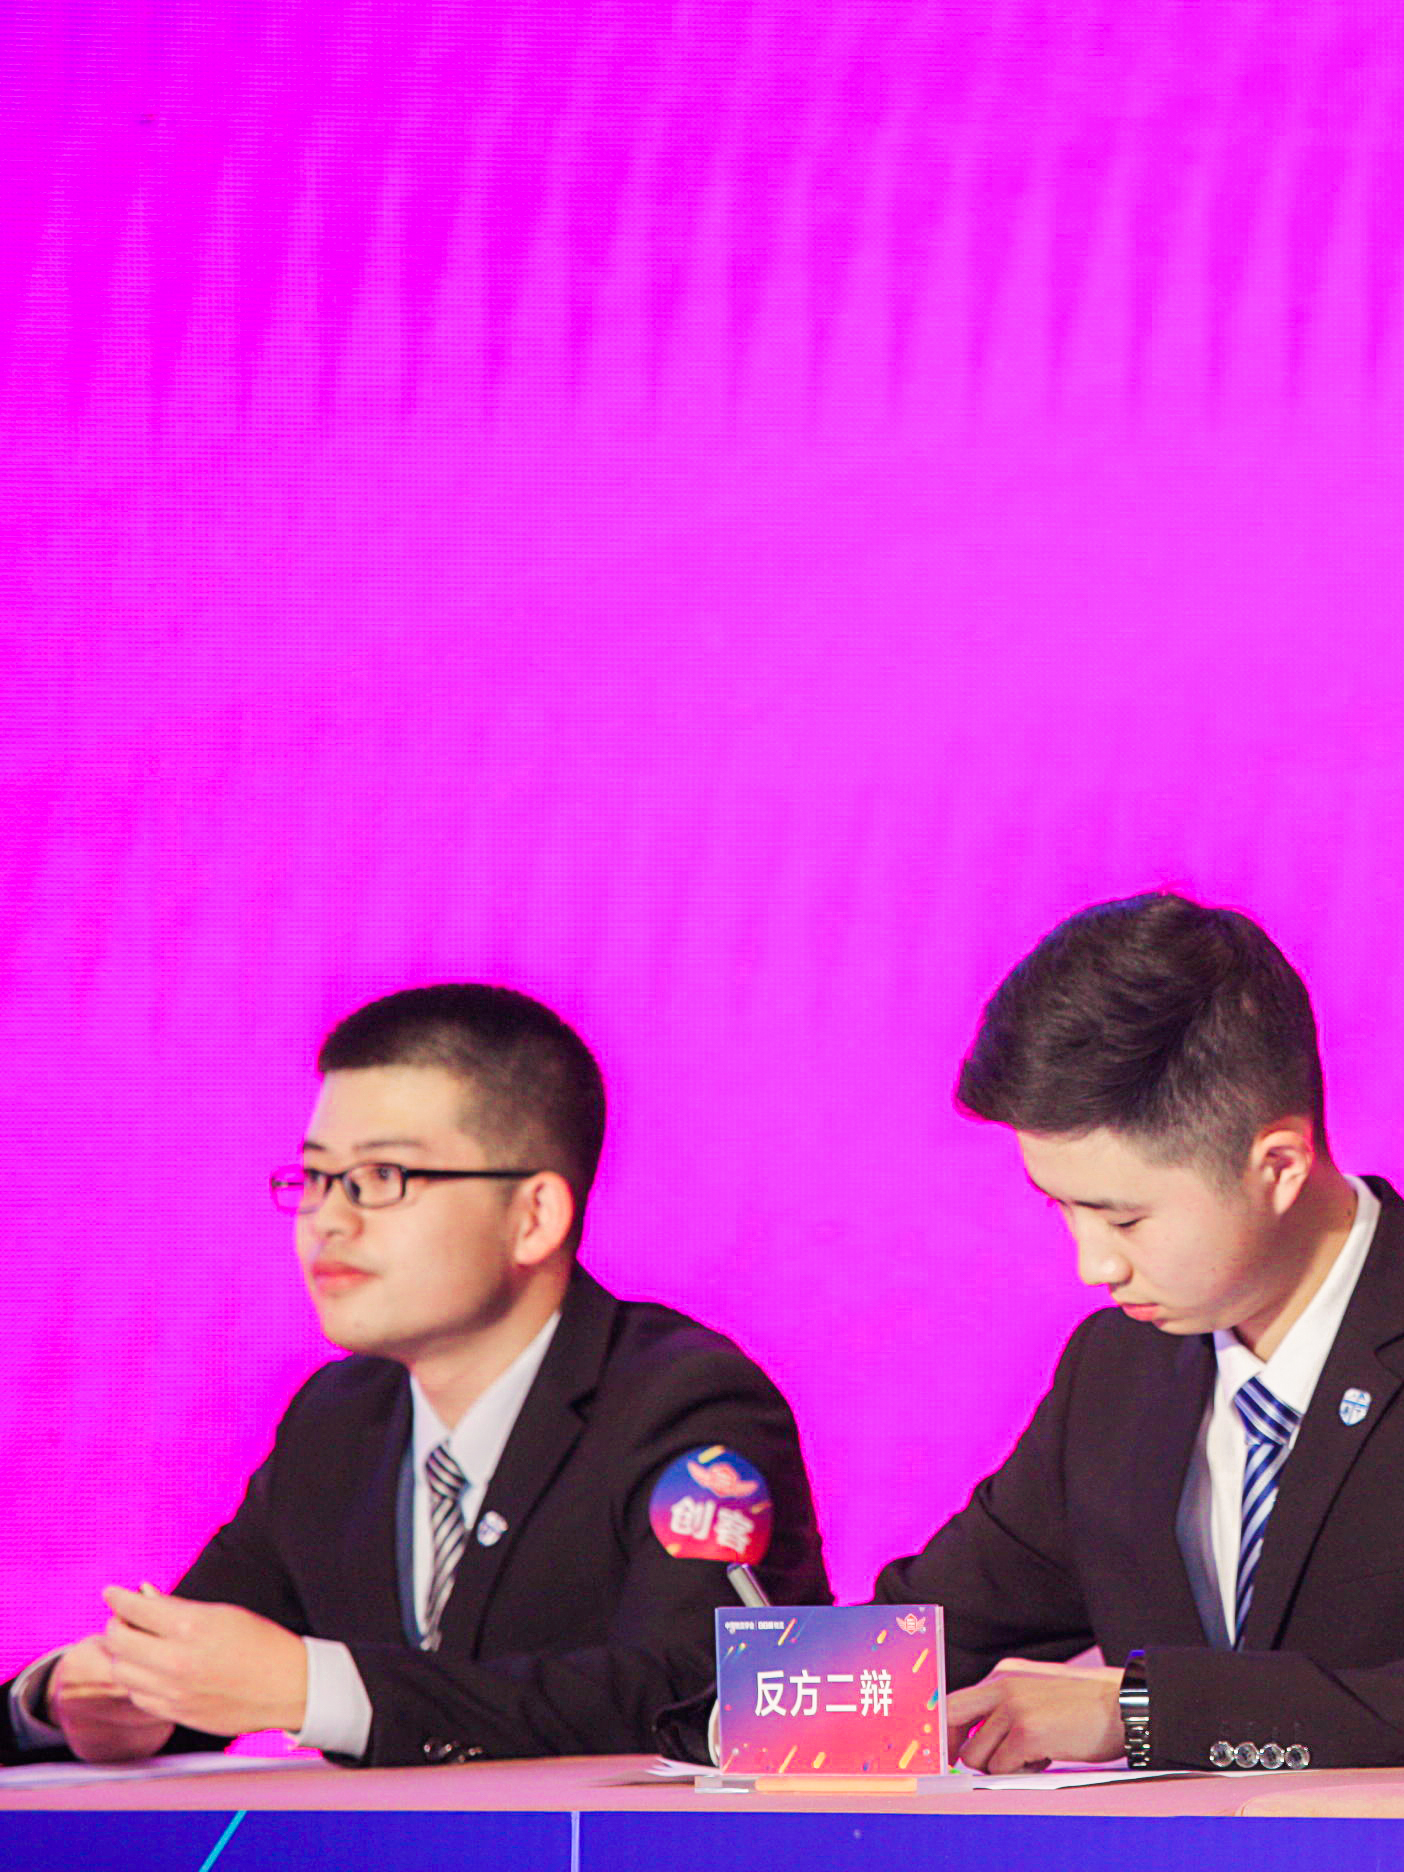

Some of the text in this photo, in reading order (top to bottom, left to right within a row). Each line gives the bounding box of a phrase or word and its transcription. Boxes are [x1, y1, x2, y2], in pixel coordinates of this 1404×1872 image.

[670, 1495, 755, 1555] 创客
[754, 1669, 893, 1717] 反方二辩
